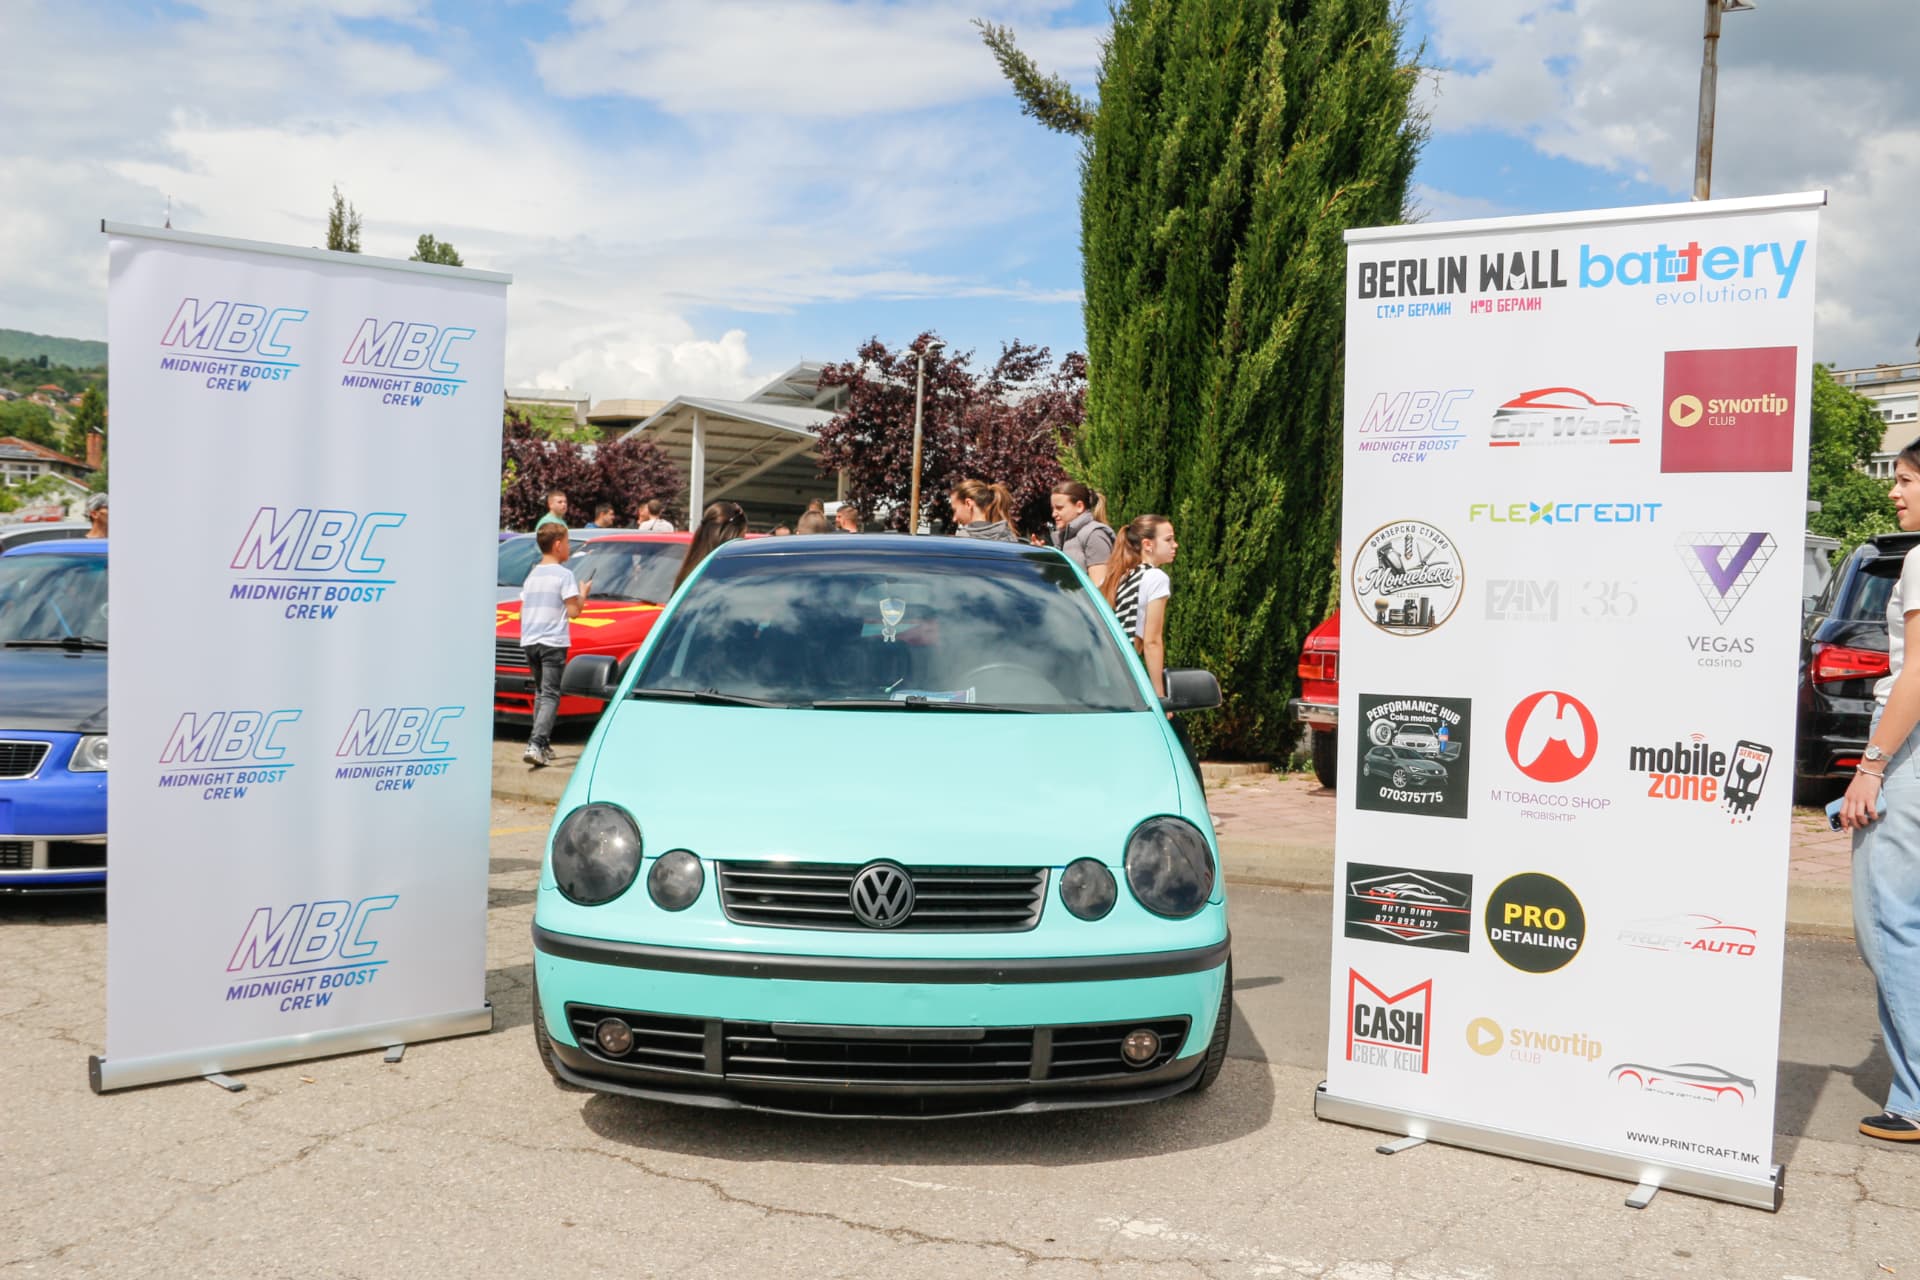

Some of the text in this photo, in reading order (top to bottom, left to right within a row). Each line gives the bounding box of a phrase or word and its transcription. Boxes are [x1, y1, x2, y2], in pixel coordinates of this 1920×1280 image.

[1358, 249, 1568, 299] BERLIN WALL
[1579, 240, 1807, 299] battery
[1497, 296, 1542, 313] БЕРЛИН
[1656, 283, 1767, 306] evolution
[1408, 302, 1452, 317] БЕРЛИН
[160, 298, 309, 357] MBC
[342, 318, 476, 374] MBC
[160, 357, 292, 381] MIDNIGHT BOOST
[206, 377, 252, 392] CREW
[341, 375, 460, 396] MIDNIGHT BOOST
[382, 393, 424, 407] CREW
[1359, 389, 1474, 433] MBC
[1708, 416, 1736, 426] CLUB
[1358, 440, 1460, 452] MIDNIGHT BOOST
[1392, 452, 1427, 463] CREW
[229, 506, 407, 573] MBC
[1419, 527, 1449, 550] СТУДИО
[229, 584, 386, 603] MIDNIGHT BOOST
[285, 604, 338, 620] CREW
[1687, 636, 1755, 653] VEGAS
[1697, 655, 1742, 668] casino
[1366, 700, 1461, 725] PERFORMANCE HUB
[1410, 715, 1438, 724] motors
[159, 709, 303, 763] MBC
[336, 706, 465, 757] MBC
[1629, 741, 1726, 777] mobile
[158, 770, 287, 787] MIDNIGHT BOOST
[335, 763, 449, 779] MIDNIGHT BOOST
[203, 786, 248, 800] CREW
[375, 778, 416, 791] CREW
[1379, 786, 1444, 803] 070375775
[1647, 773, 1718, 803] zone
[1491, 789, 1611, 810] M TOBACCO SHOP
[1520, 809, 1577, 822] PROBISHTIP
[1375, 914, 1394, 923] 077
[1381, 904, 1406, 914] AUTO
[1504, 903, 1566, 931] PRO
[226, 894, 400, 972] MBC
[1491, 927, 1577, 950] DETAILING
[225, 968, 379, 1001] MIDNIGHT BOOST
[279, 992, 333, 1012] CREW
[1354, 1003, 1423, 1046] CASH
[1353, 1044, 1421, 1073] СВЕЖ КЕШ
[1510, 1049, 1541, 1064] CLUB
[1627, 1131, 1760, 1165] WWW.PRINTCRAFT.MK
